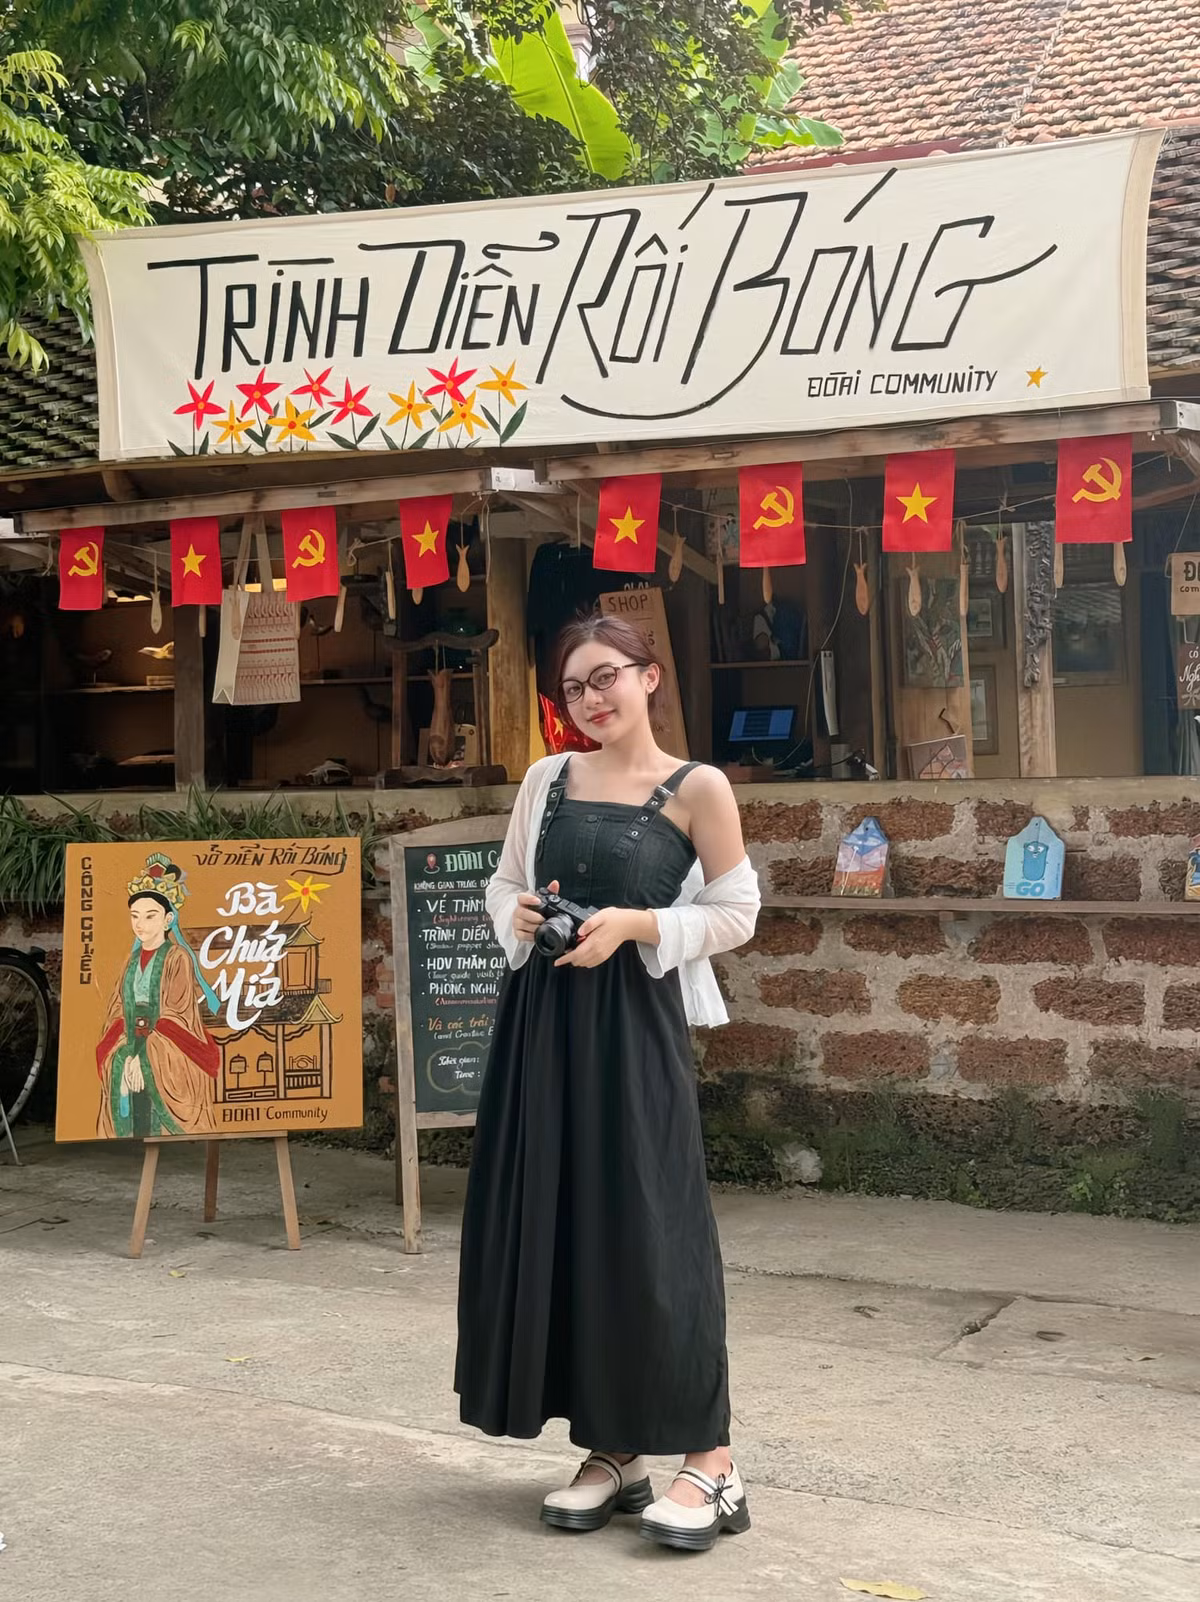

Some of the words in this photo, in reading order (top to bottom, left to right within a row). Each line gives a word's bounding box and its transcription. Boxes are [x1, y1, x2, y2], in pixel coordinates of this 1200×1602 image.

[358, 231, 560, 355] DIỄN
[535, 183, 715, 383] RỐI
[560, 168, 1057, 419] BÓNG
[147, 253, 369, 380] TRÌNH
[869, 365, 998, 395] COMMUNITY
[608, 594, 648, 612] SHOP
[221, 843, 265, 866] DIỄN
[262, 842, 297, 866] RỐI
[291, 844, 347, 876] BÓNG
[80, 856, 93, 911] CÔNG
[216, 881, 285, 917] Bà
[437, 880, 455, 890] GIAN
[1016, 881, 1046, 897] GO
[426, 893, 447, 913] VÉ
[452, 896, 484, 913] THĂM
[199, 919, 288, 969] Chúa
[421, 926, 456, 942] TRÌNH
[461, 923, 490, 942] DIỄN
[79, 916, 94, 985] CHIẾU
[427, 957, 452, 970] HDV
[456, 954, 487, 969] THĂM
[197, 962, 285, 1031] Mía
[429, 978, 466, 995] PHÒNG
[428, 1016, 443, 1031] Và
[447, 1016, 464, 1029] các
[266, 1106, 328, 1123] Community
